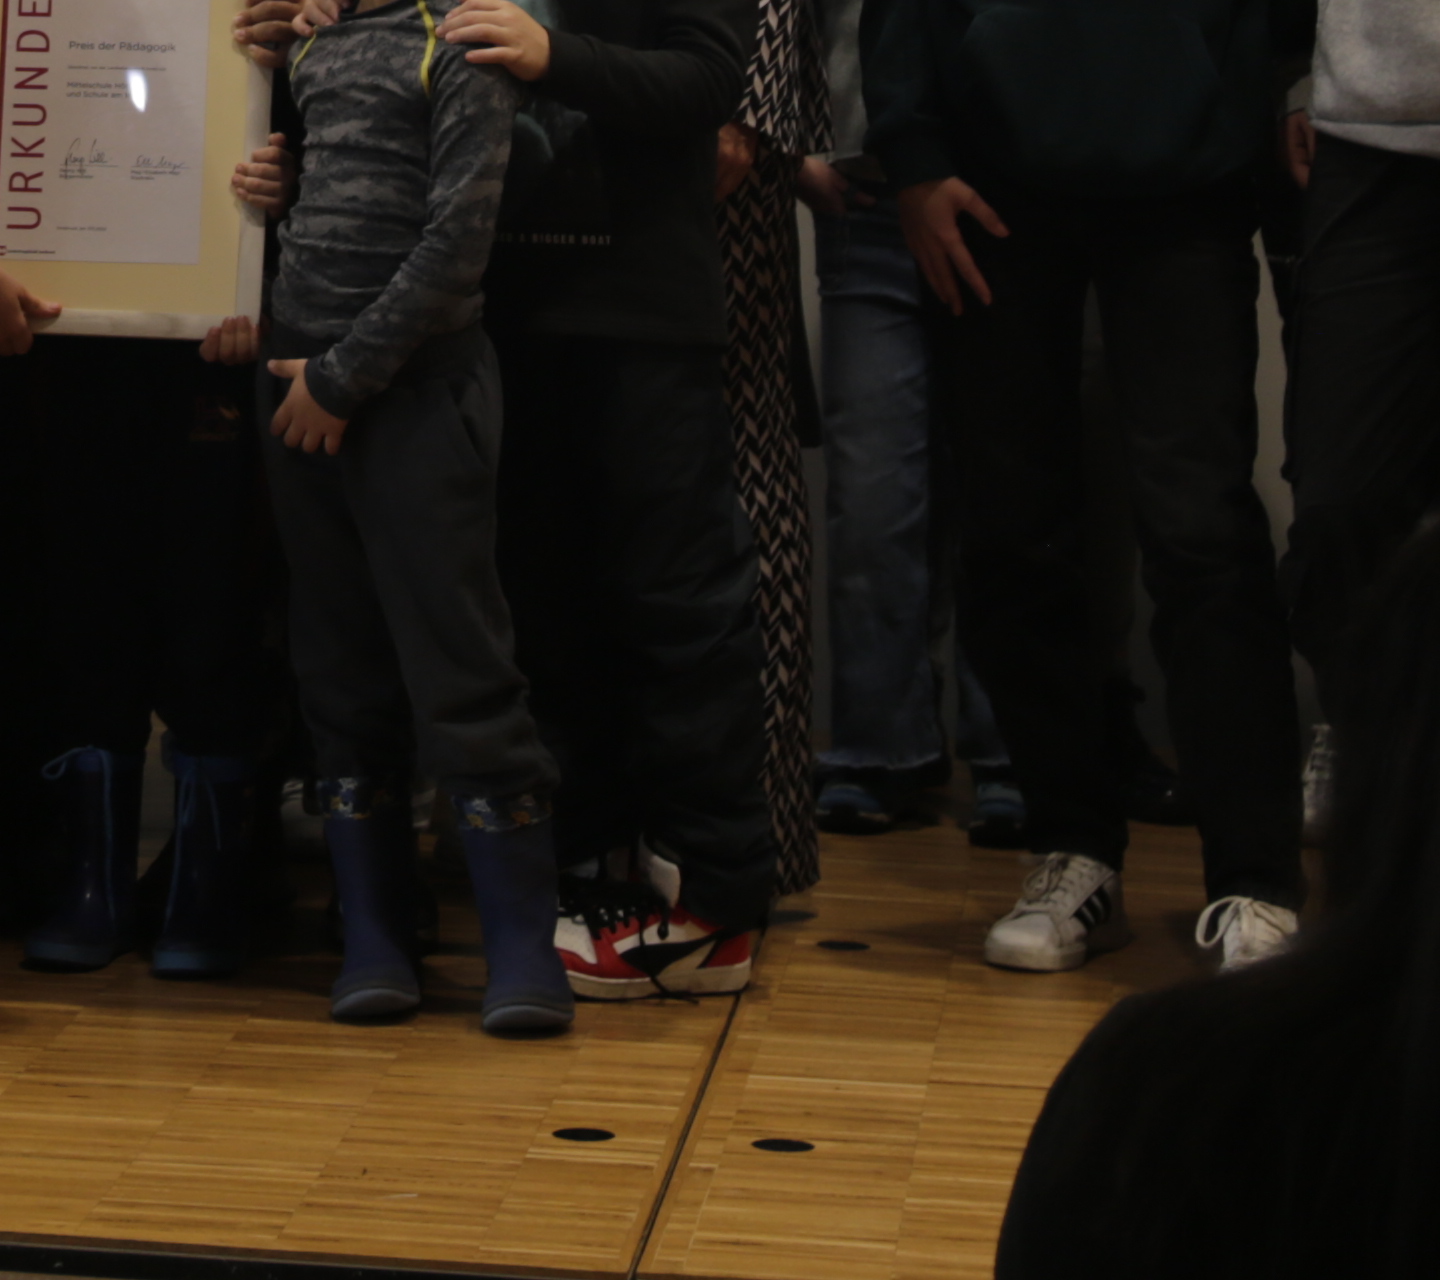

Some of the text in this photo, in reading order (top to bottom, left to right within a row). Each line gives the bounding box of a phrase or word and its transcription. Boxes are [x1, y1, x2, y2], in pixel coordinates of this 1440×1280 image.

[69, 40, 176, 53] Preis der Pädagogik
